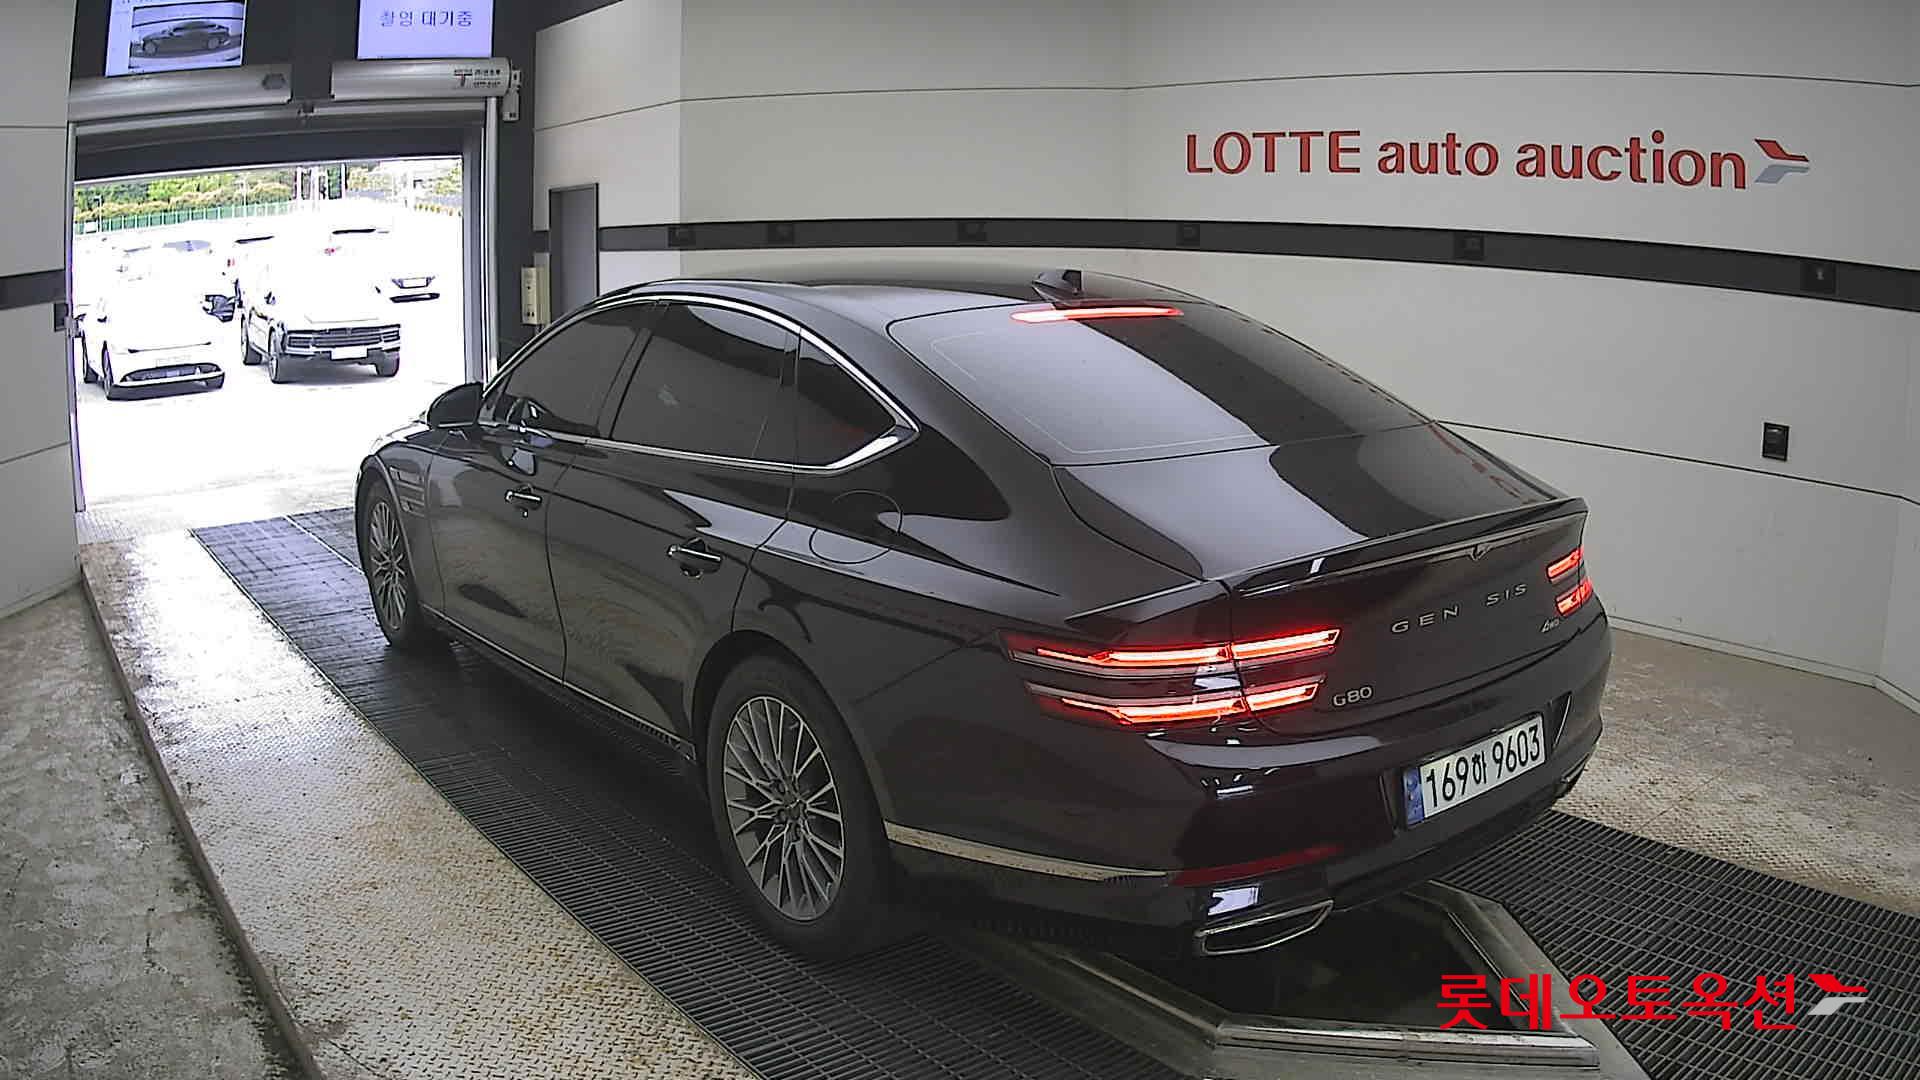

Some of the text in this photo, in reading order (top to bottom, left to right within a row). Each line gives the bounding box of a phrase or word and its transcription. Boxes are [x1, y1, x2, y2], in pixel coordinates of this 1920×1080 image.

[421, 10, 472, 27] 대기중
[1187, 130, 1748, 189] LOTTE auto auction
[1391, 583, 1527, 633] GENSIS
[1333, 686, 1372, 706] G80
[1426, 724, 1540, 808] 169하 9603
